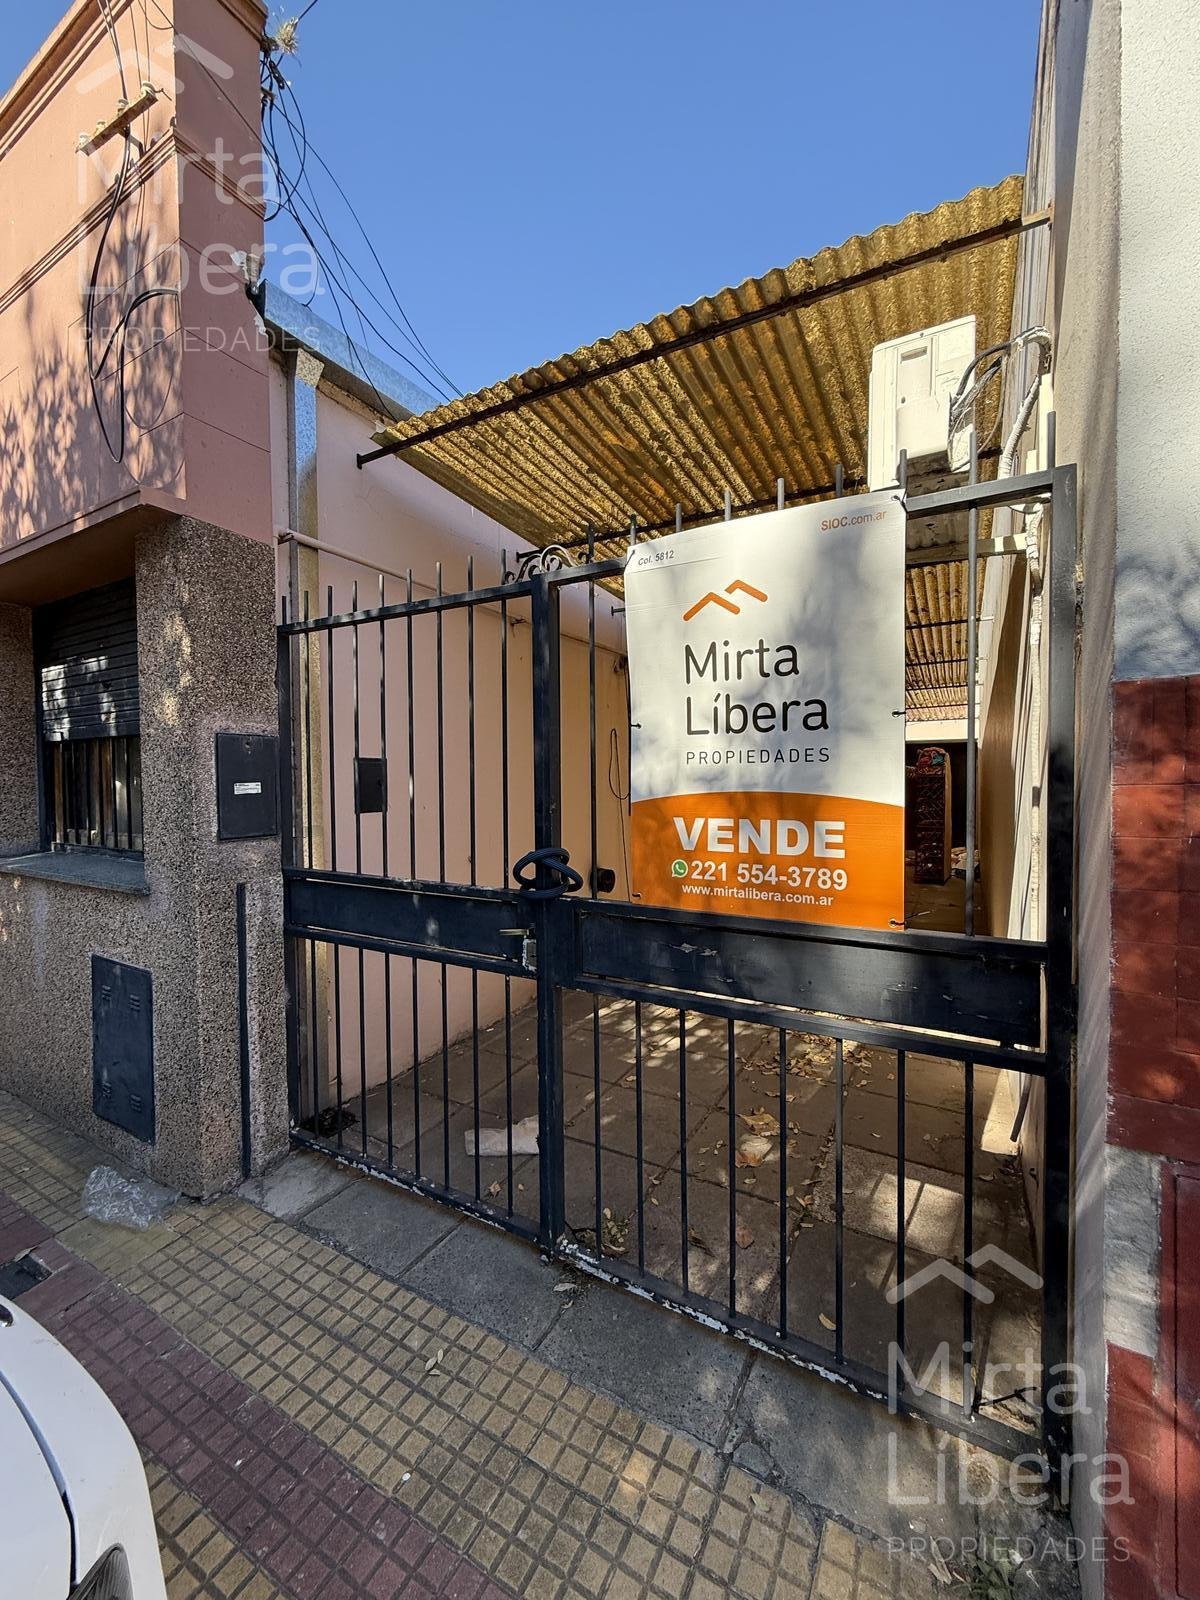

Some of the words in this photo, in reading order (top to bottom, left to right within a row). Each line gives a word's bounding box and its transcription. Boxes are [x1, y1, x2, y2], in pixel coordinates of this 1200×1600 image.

[821, 511, 887, 532] SIOC.com.ar
[638, 555, 653, 566] Col.
[655, 550, 674, 563] 5812
[684, 638, 800, 685] Mirta
[686, 693, 829, 736] Líbera
[686, 747, 830, 765] PROPIEDADES
[673, 816, 846, 859] VENDE
[691, 860, 728, 882] 221
[736, 863, 848, 891] 554-3789
[681, 883, 834, 906] www.mirtalibera.com.ar
